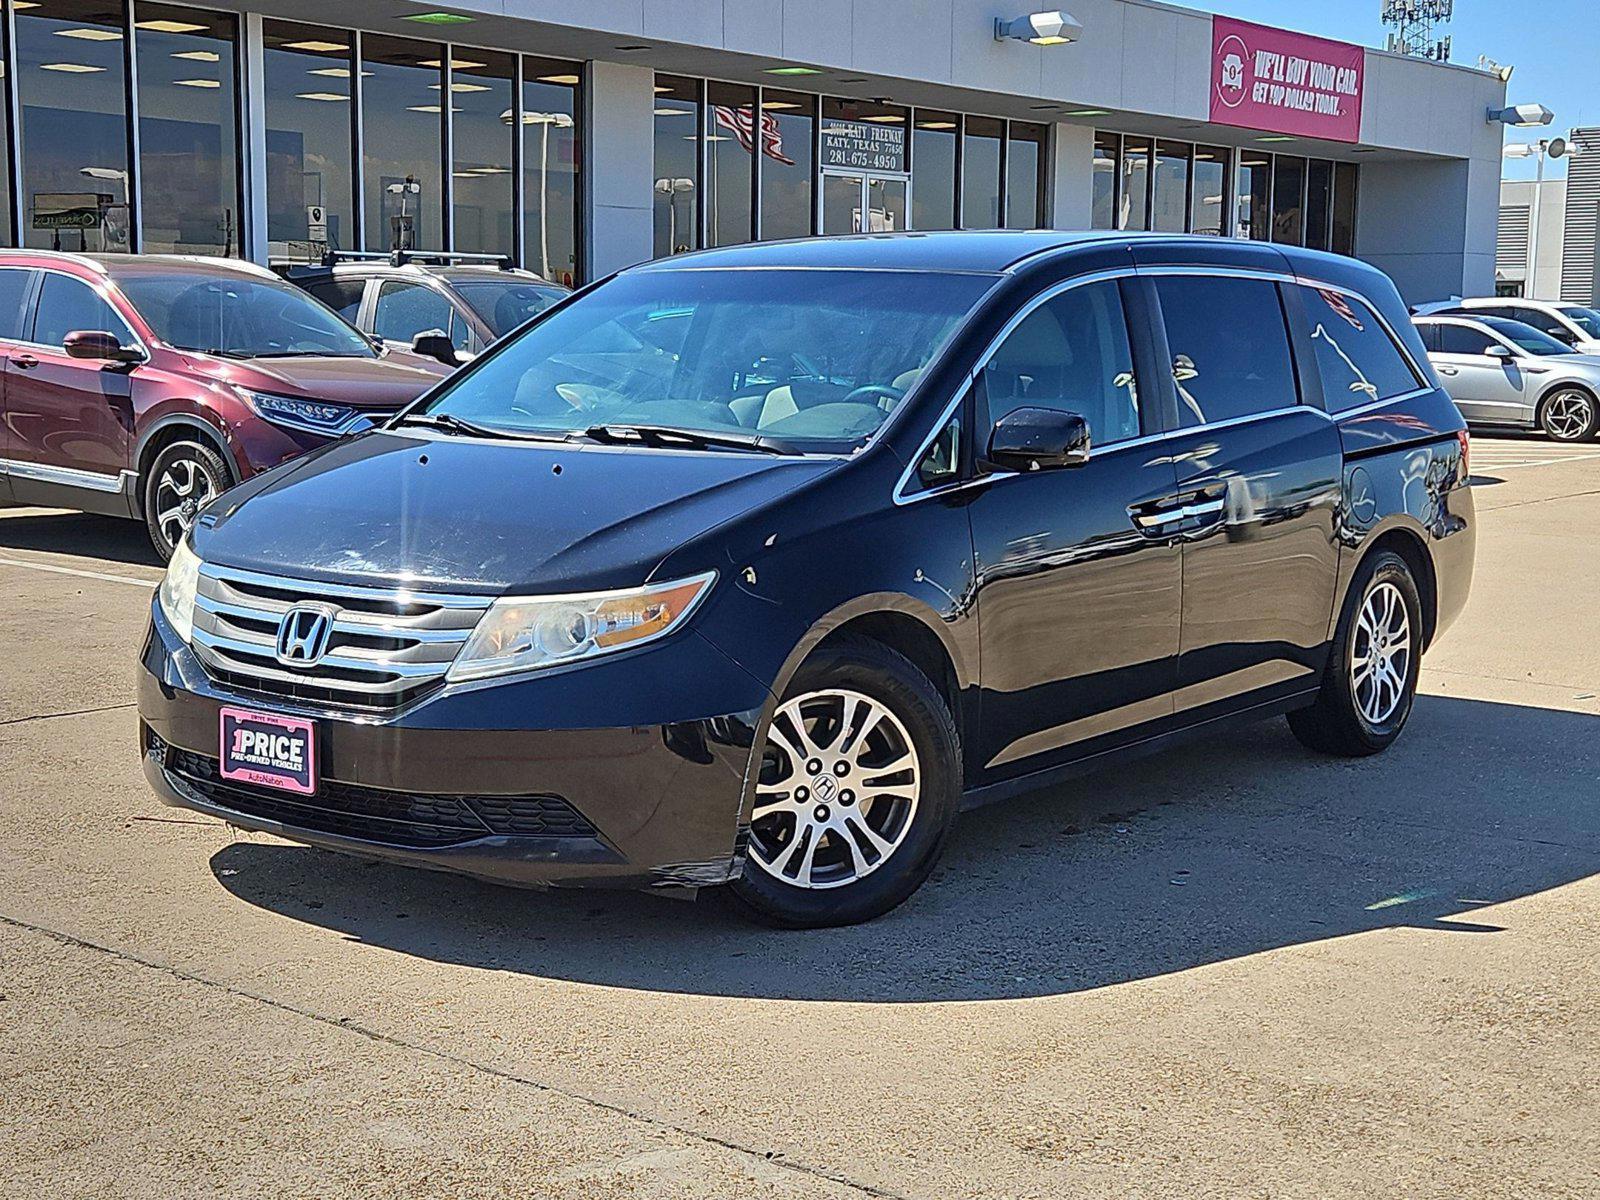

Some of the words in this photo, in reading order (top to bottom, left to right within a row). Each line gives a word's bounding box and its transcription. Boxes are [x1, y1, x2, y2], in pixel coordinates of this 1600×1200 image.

[1254, 50, 1285, 81] WE'LL
[1286, 56, 1310, 86] BUY
[1309, 60, 1336, 91] YOUR
[1336, 67, 1358, 96] CAR.
[1252, 82, 1269, 103] GET
[1269, 84, 1285, 106] TOP
[1284, 87, 1314, 111] DOLLAR
[1314, 93, 1340, 116] TODAY.
[847, 124, 867, 139] KATY
[871, 127, 903, 144] FREEWAY
[853, 139, 880, 152] TEXAS
[829, 150, 896, 169] 281-675-4950
[230, 751, 271, 766] PRE-OWNED
[271, 758, 303, 772] VEHICLES
[248, 773, 284, 787] AutoNation
